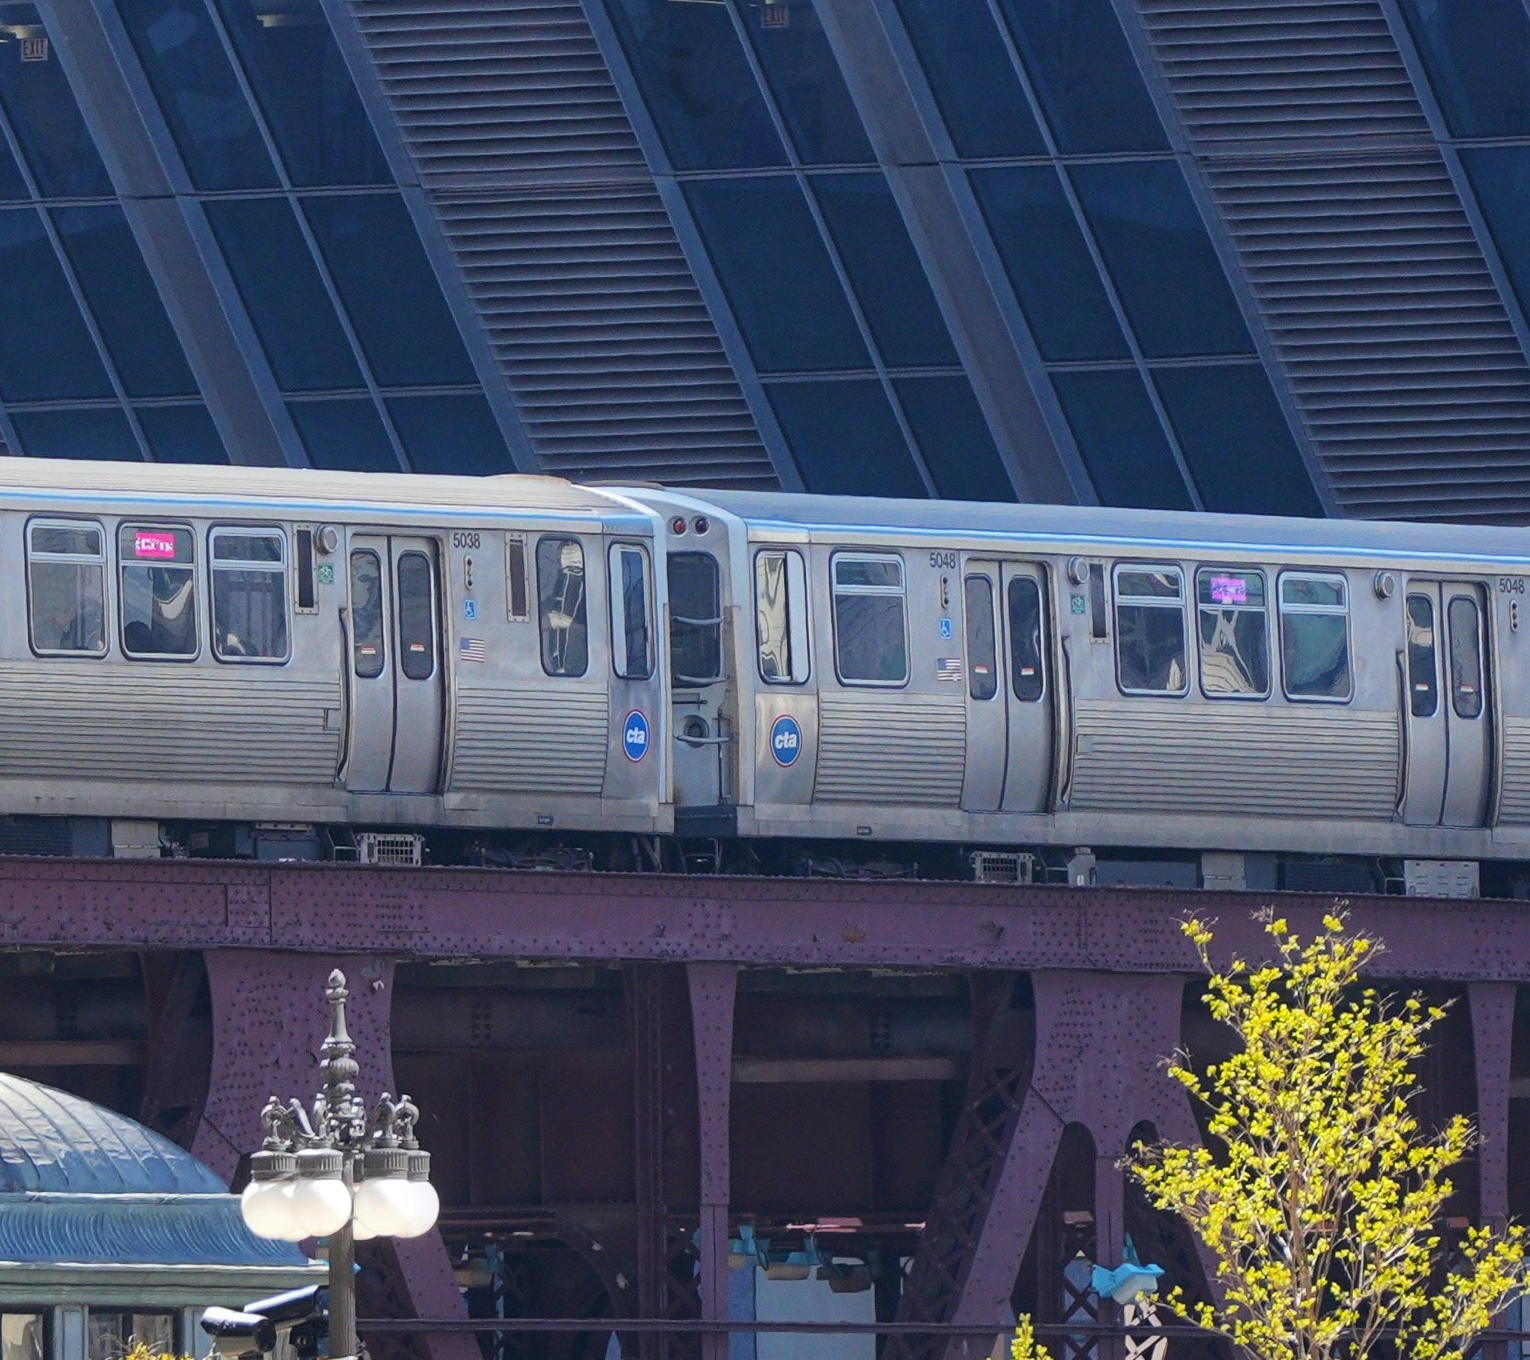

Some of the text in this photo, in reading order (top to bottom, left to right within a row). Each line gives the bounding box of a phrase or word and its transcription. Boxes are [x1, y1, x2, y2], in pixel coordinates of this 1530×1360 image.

[453, 532, 481, 549] 5038
[929, 552, 956, 569] 5048
[1499, 578, 1525, 595] 5048
[625, 726, 646, 745] cta
[774, 731, 797, 749] cta
